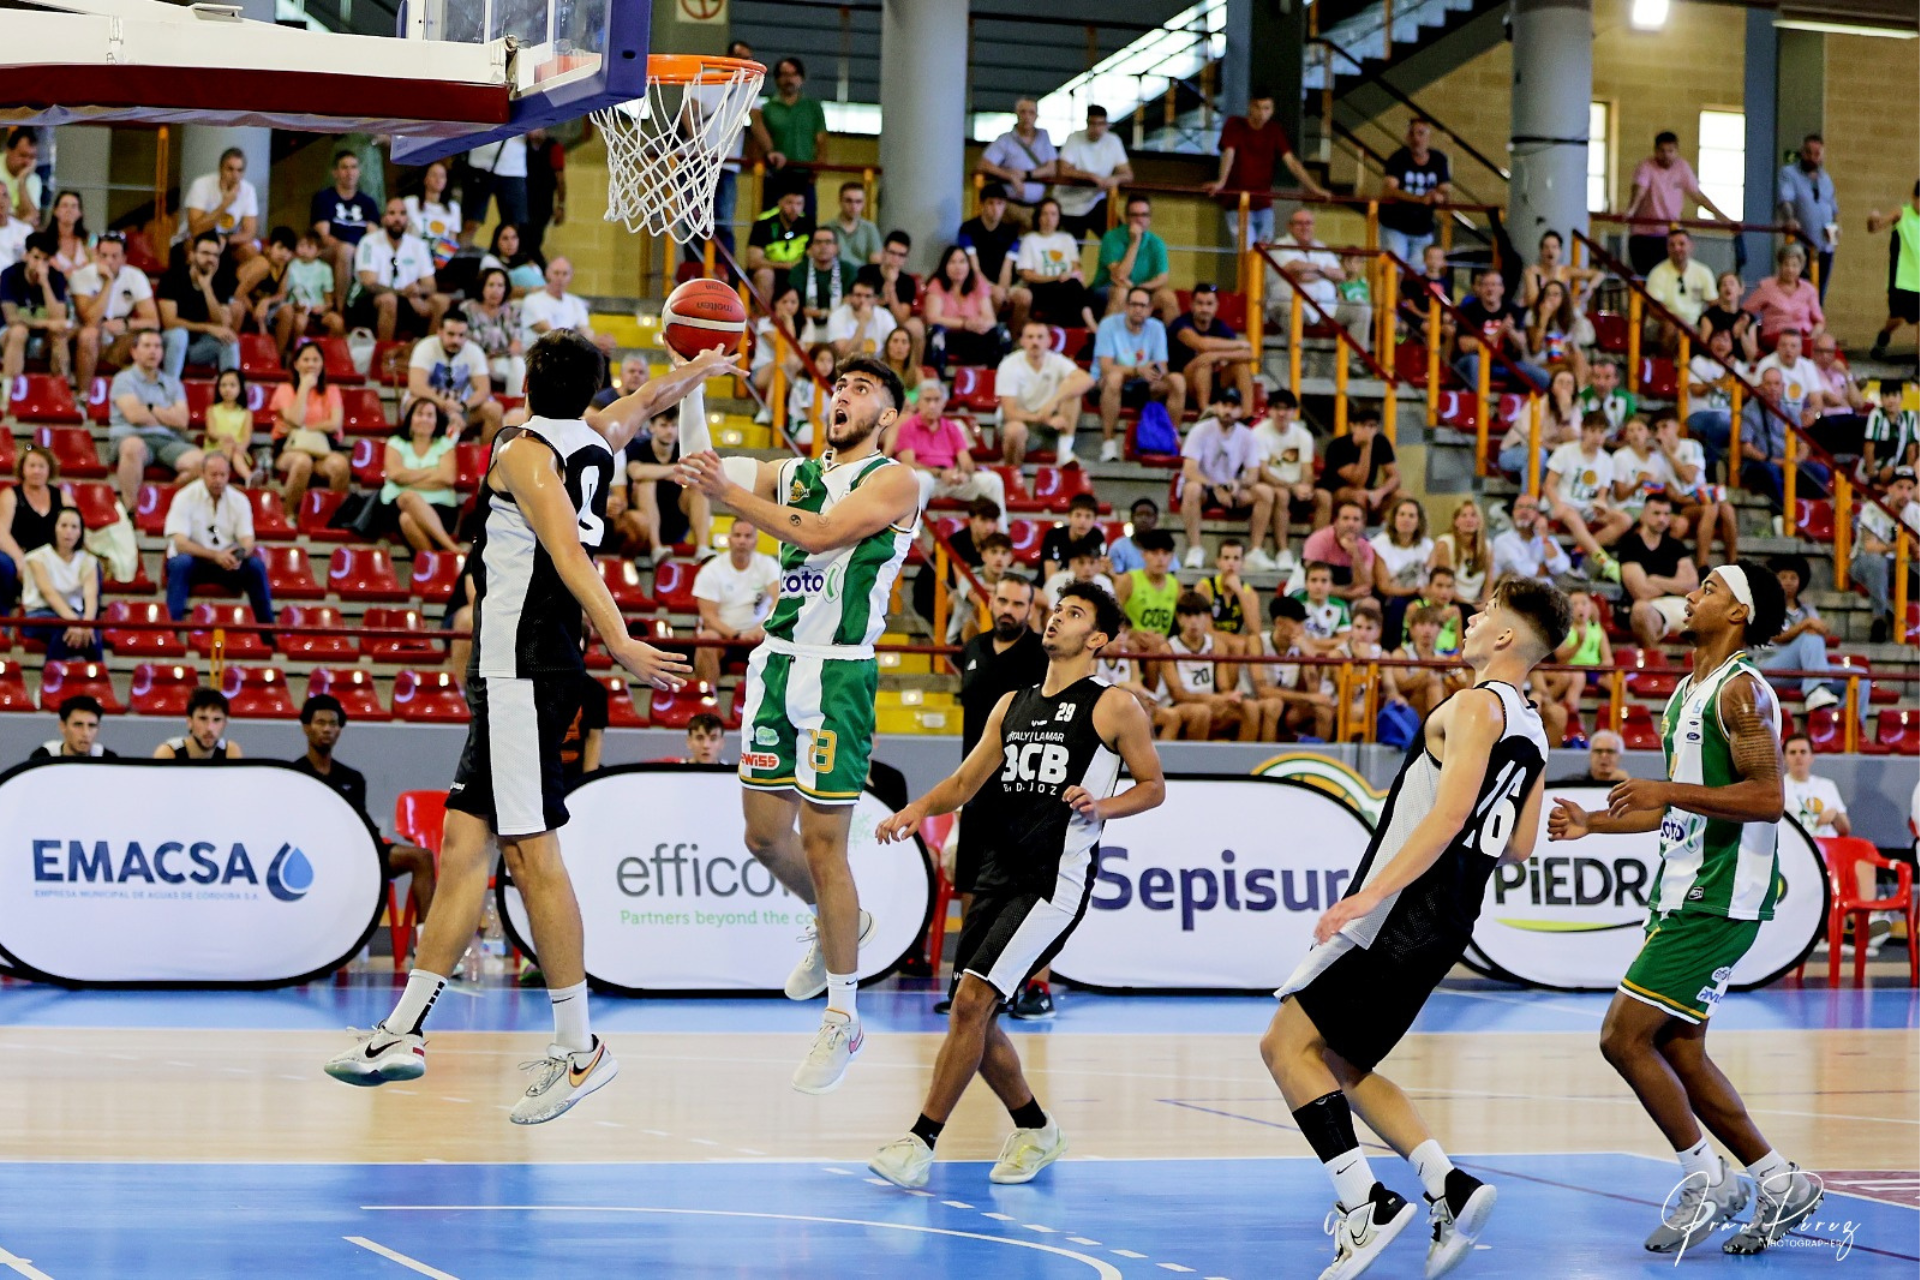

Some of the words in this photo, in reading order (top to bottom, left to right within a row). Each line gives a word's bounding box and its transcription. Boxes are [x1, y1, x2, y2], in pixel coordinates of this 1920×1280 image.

[697, 302, 733, 312] molten
[1054, 702, 1076, 722] 29
[1462, 759, 1527, 858] 16
[32, 839, 259, 885] EMACSA
[616, 842, 791, 898] effico
[1091, 846, 1350, 931] Sepisur
[620, 910, 690, 925] Partners
[696, 909, 758, 928] beyond
[763, 910, 790, 925] the
